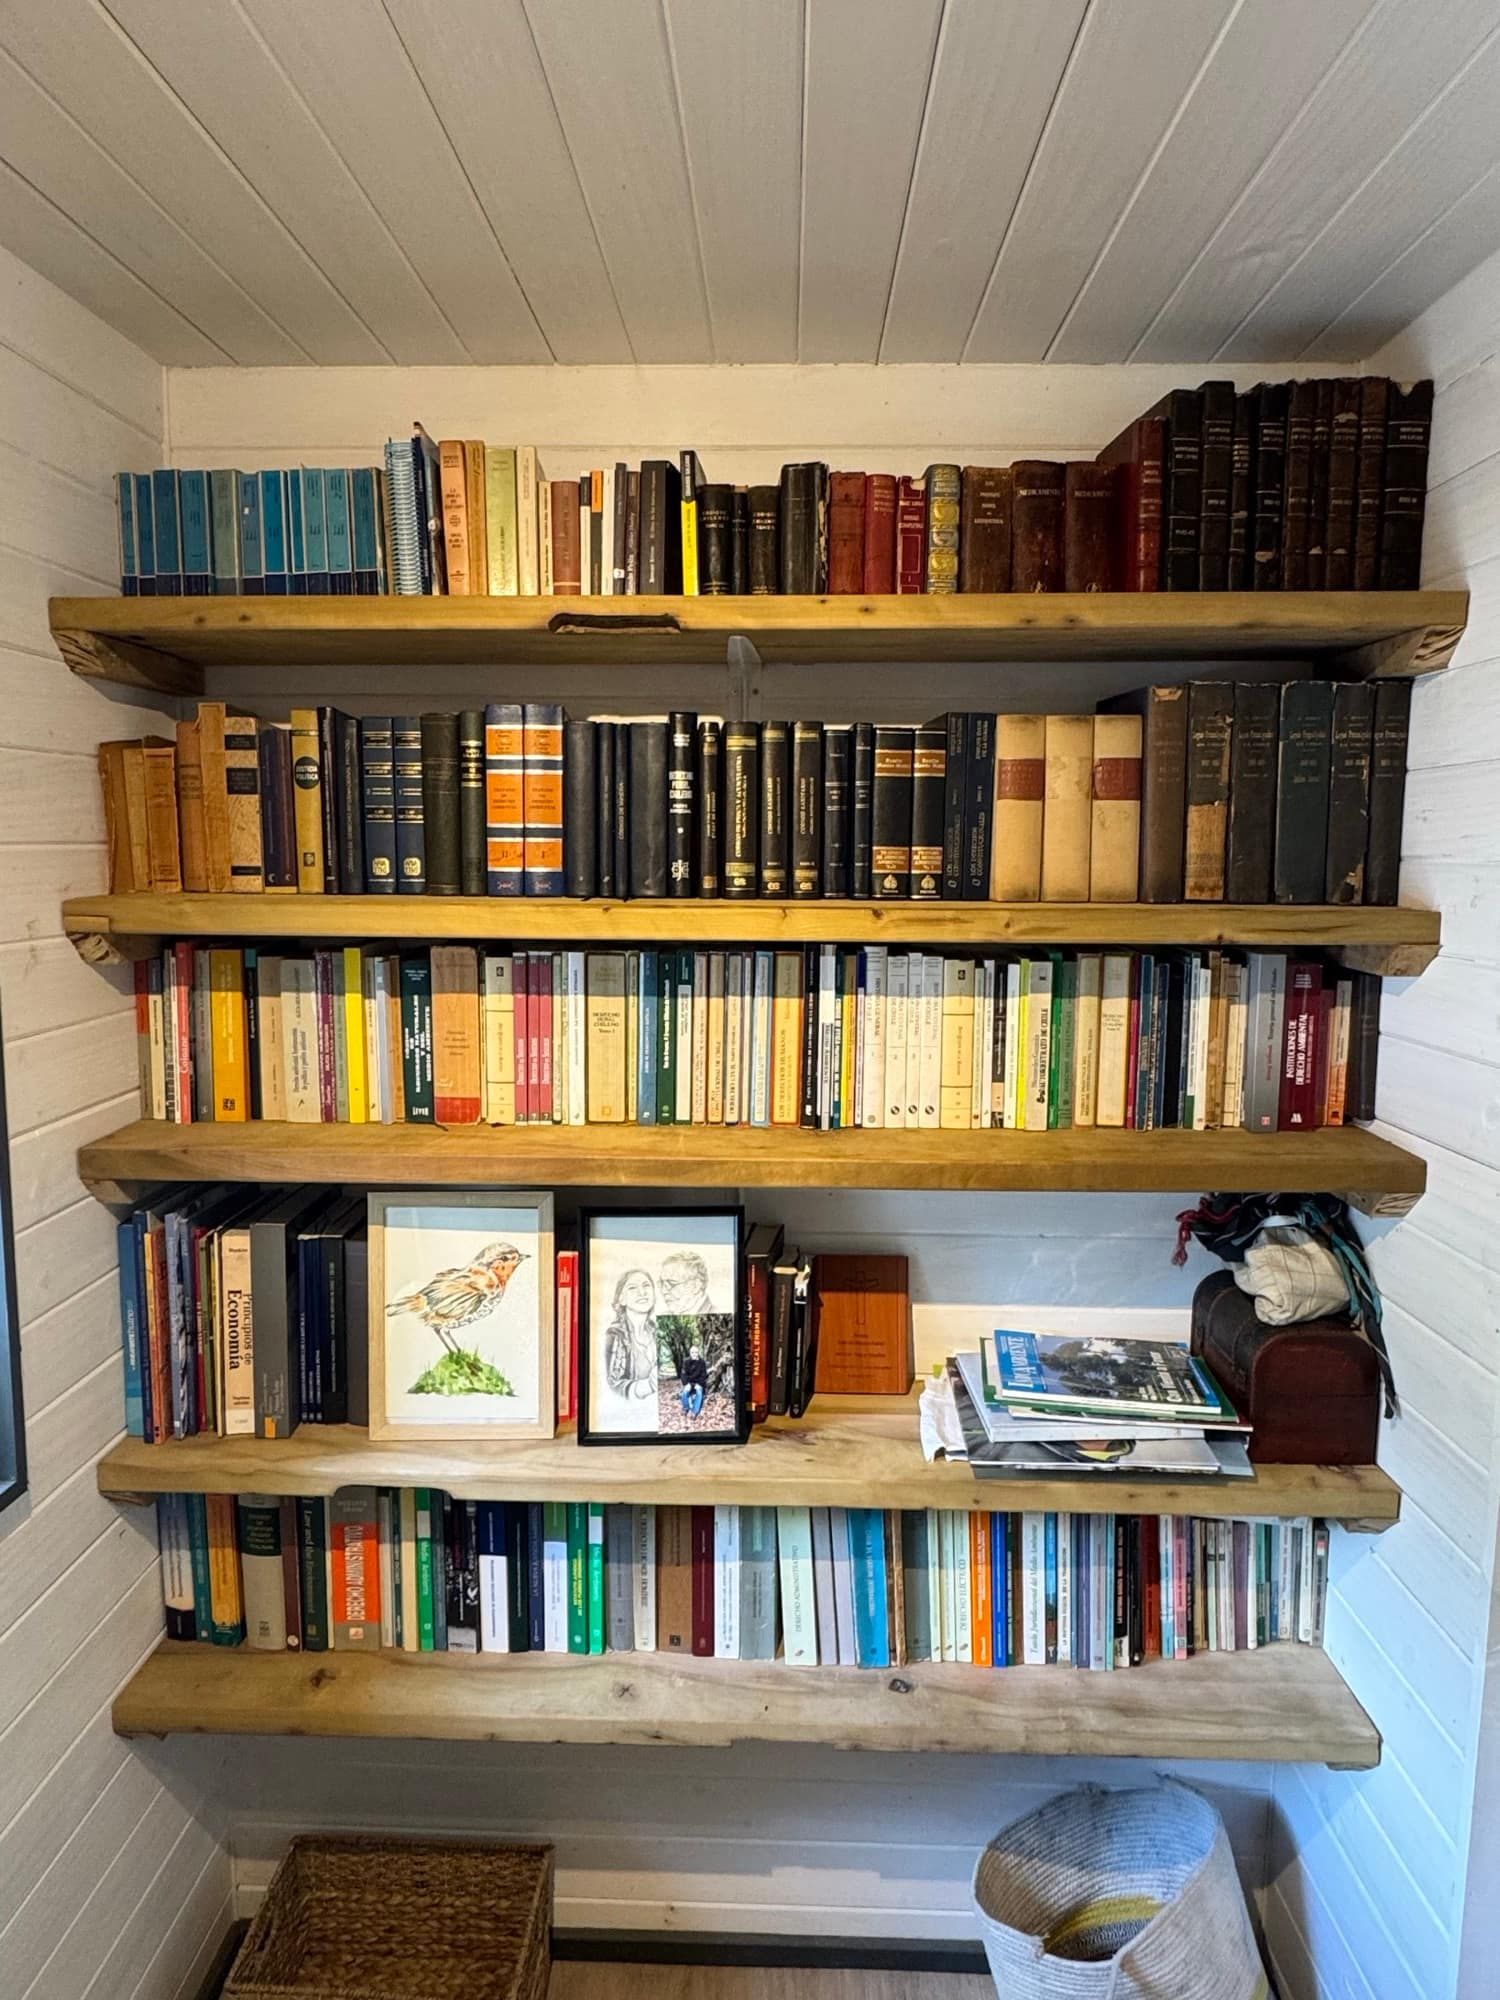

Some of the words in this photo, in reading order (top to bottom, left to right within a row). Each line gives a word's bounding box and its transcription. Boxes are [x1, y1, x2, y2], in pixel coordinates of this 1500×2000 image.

[1288, 1019, 1297, 1030] DE
[1297, 1013, 1308, 1052] AMBIENTAL
[1286, 1030, 1297, 1078] INSTITUCIONES
[1295, 1053, 1306, 1085] DERECHO
[228, 1289, 243, 1370] Economía
[242, 1293, 253, 1351] Principios
[244, 1352, 253, 1365] de
[753, 1346, 761, 1376] PASCAL
[344, 1526, 365, 1586] ADMINISTRATIVO
[346, 1587, 366, 1621] DERECHO
